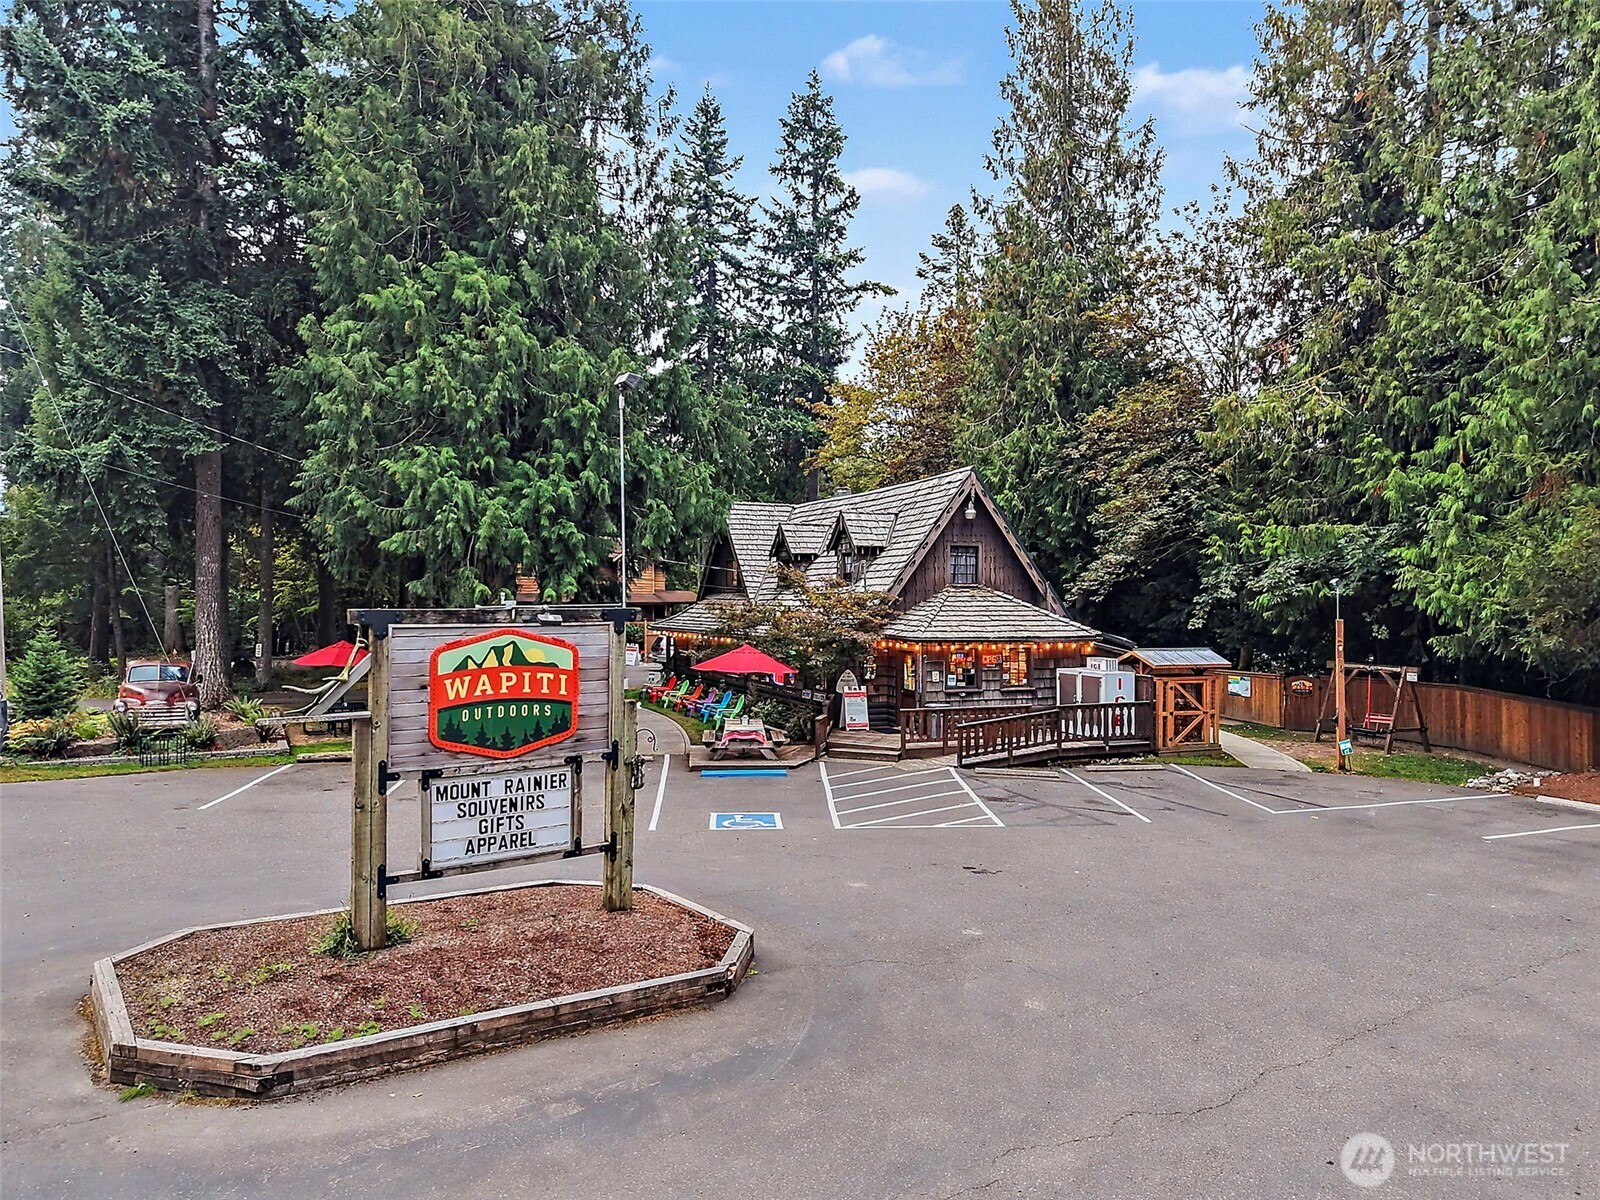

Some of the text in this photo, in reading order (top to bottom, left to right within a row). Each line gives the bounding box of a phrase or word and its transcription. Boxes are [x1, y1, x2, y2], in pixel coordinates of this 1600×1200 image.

[444, 672, 568, 700] WAPITI
[462, 704, 552, 722] OUTDOORS
[435, 773, 567, 802] MOUNT RAINIER
[457, 794, 545, 818] SOUVENIRS
[479, 815, 524, 834] GIFTS
[465, 831, 536, 855] APPAREL
